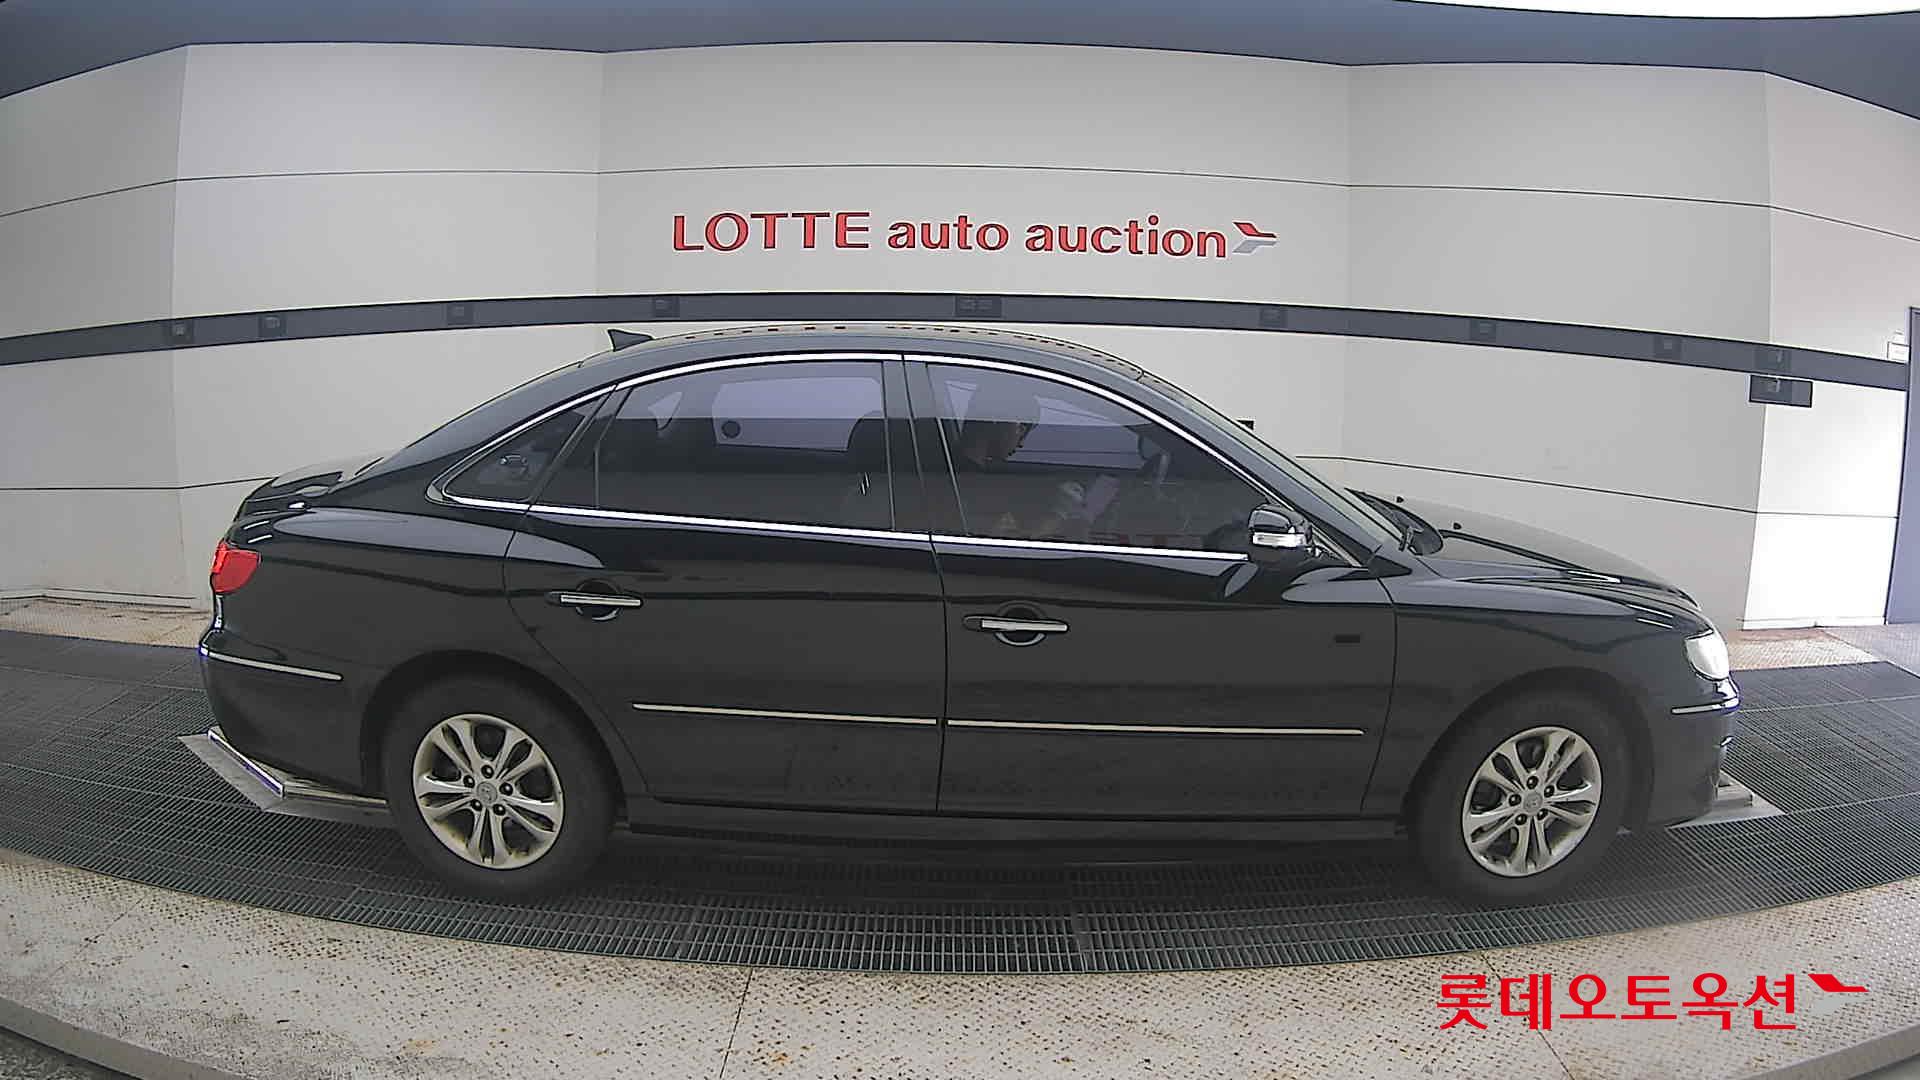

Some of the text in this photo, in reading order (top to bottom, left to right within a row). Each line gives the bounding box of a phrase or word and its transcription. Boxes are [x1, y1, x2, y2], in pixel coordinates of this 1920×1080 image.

[673, 211, 1227, 258] LOTTE auto auction
